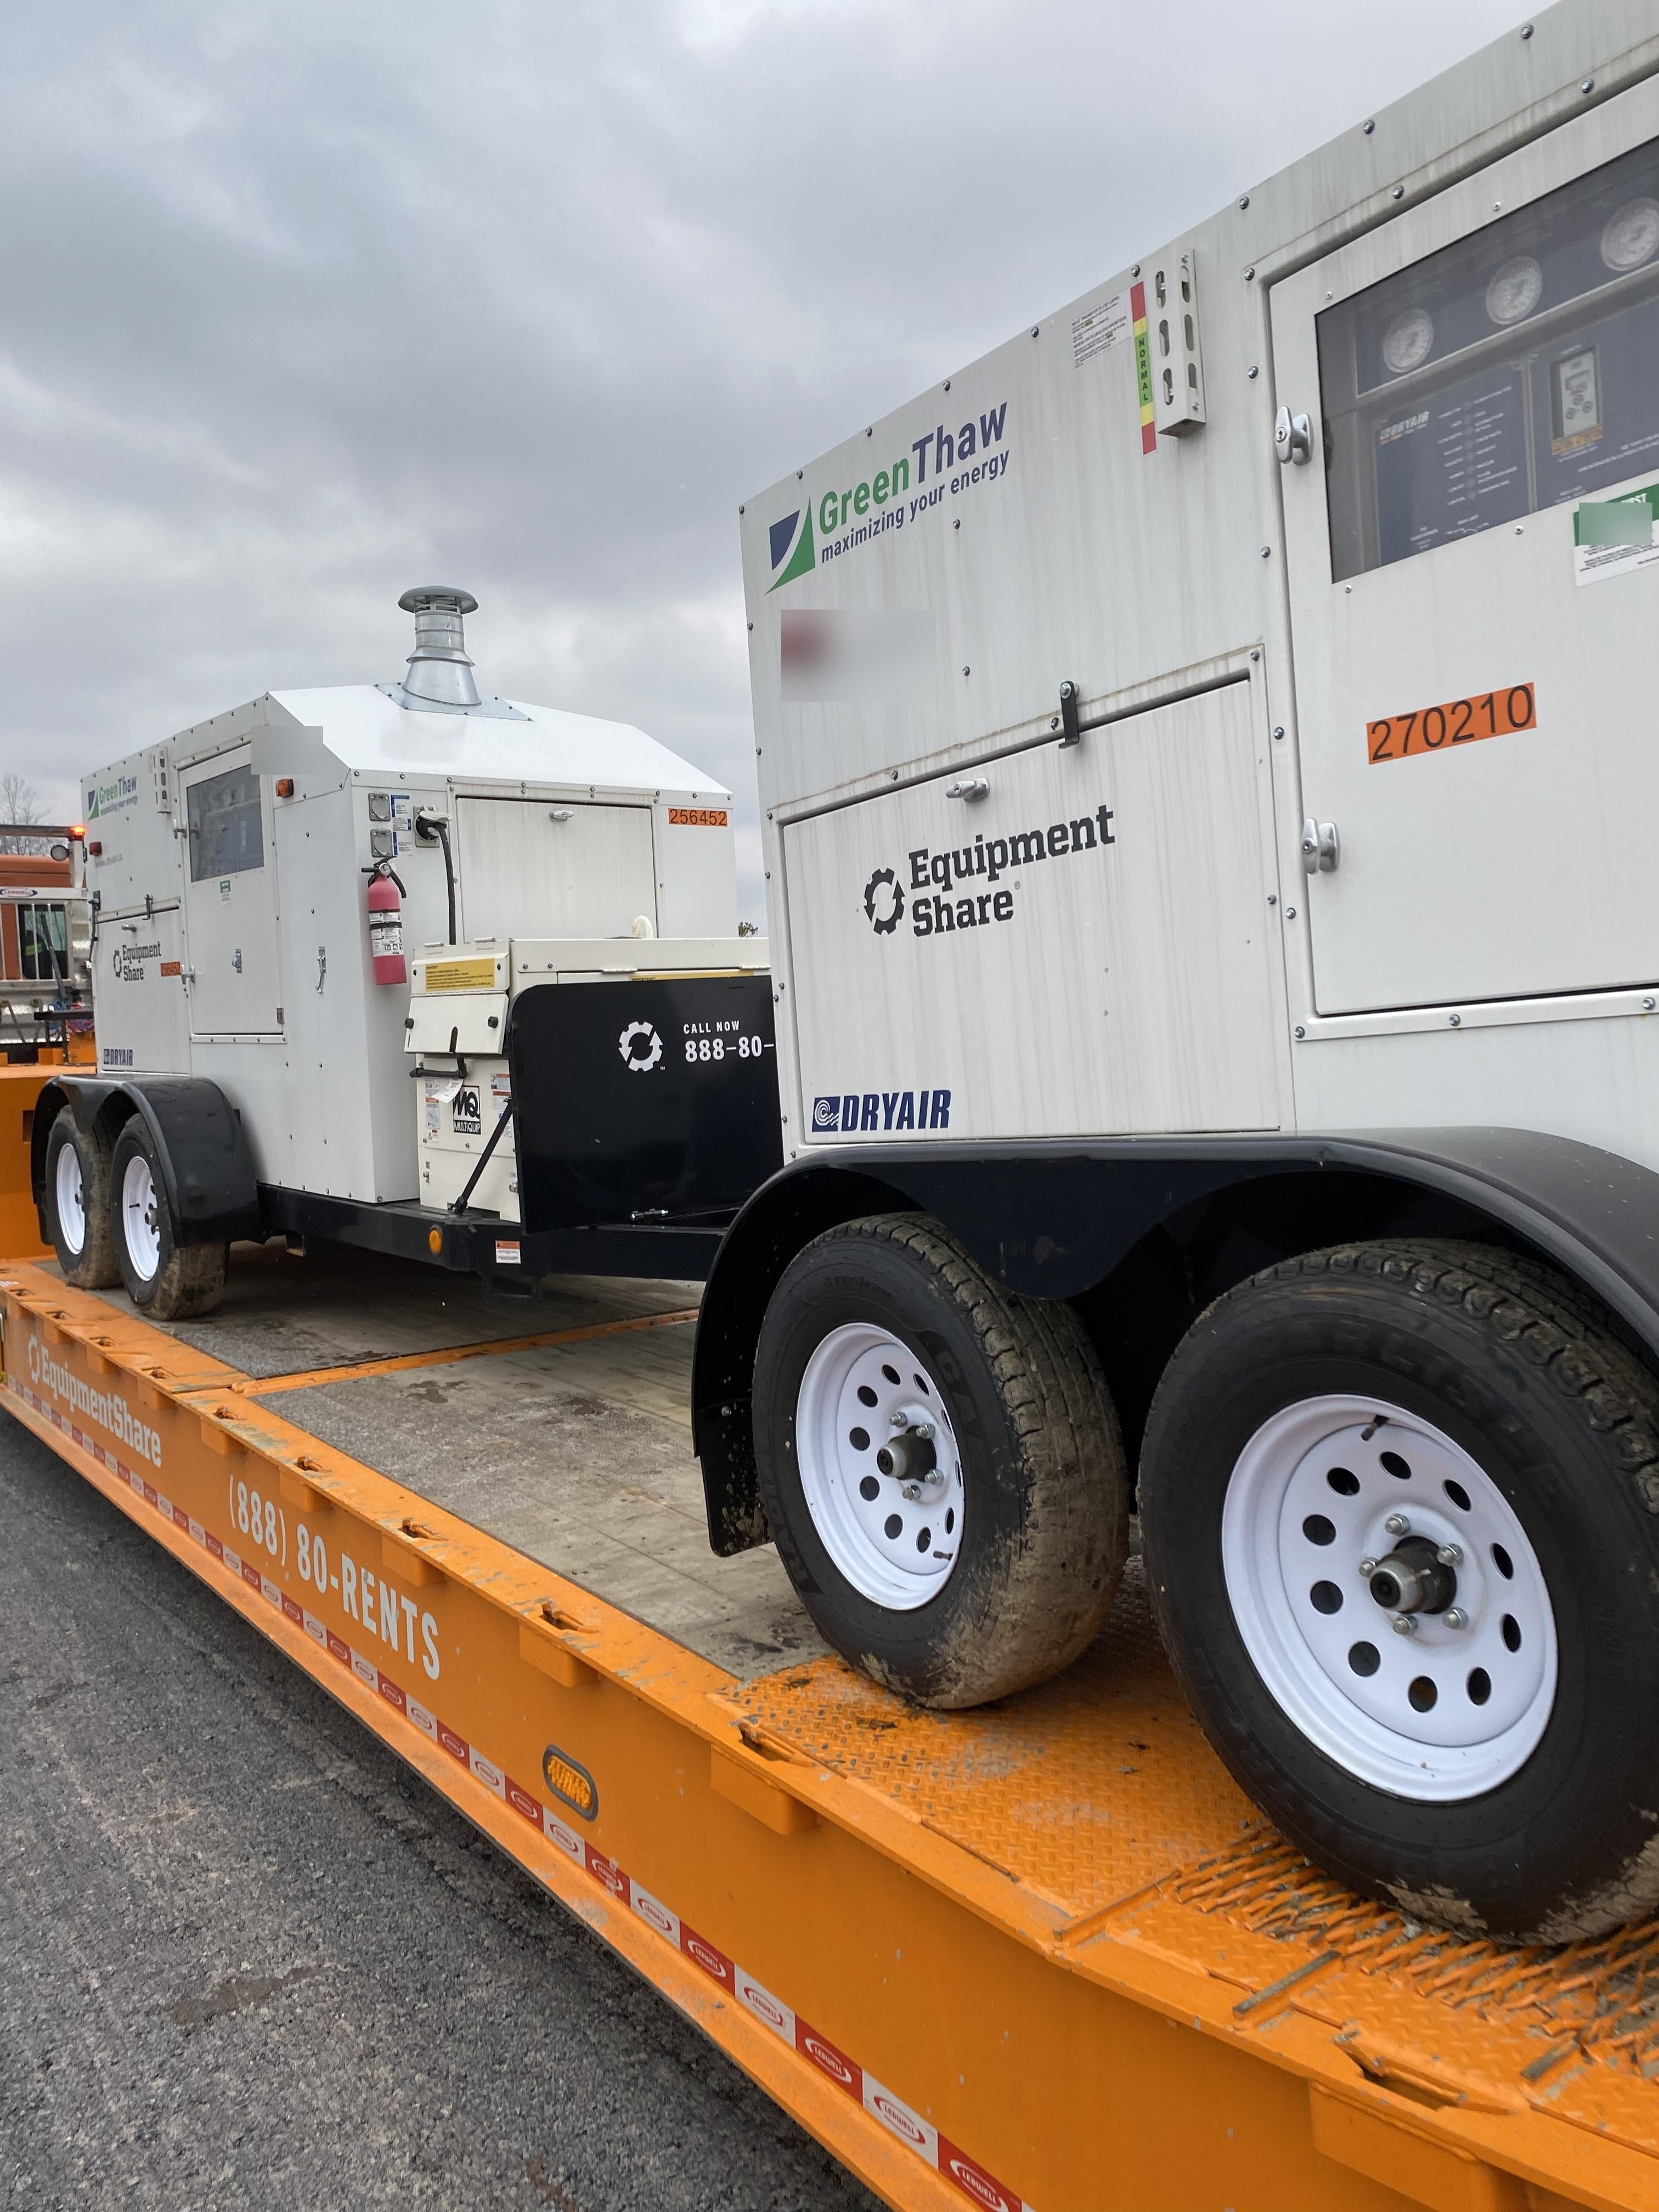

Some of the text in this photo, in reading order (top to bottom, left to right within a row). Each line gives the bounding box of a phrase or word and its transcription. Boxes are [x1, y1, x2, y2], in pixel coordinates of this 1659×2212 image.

[1138, 337, 1149, 402] NORMAL
[819, 402, 1007, 535] GreenThaw
[821, 449, 1009, 563] maximizing your energy
[1371, 685, 1532, 761] 270210
[99, 775, 137, 805] GreenThaw
[670, 809, 727, 826] 256452
[909, 804, 1116, 892] Equipment
[912, 890, 1014, 938] Share
[122, 941, 161, 964] Equipment
[123, 965, 144, 981] Share
[684, 1020, 740, 1034] CALL NOW
[110, 1048, 133, 1066] DRYAIR
[453, 1091, 481, 1119] MQ
[841, 1090, 951, 1132] DRYAIR
[454, 1121, 481, 1133] MULTIQUIP
[41, 1345, 162, 1469] EquipmentShare
[229, 1474, 440, 1680] (888) 80-RENTS
[696, 1947, 719, 1971] LEDWELL
[752, 1994, 776, 2019] LEDWELL
[815, 2046, 842, 2074] LEDWELL
[884, 2104, 914, 2136] LEDWELL
[962, 2168, 997, 2205] LEDWELL
